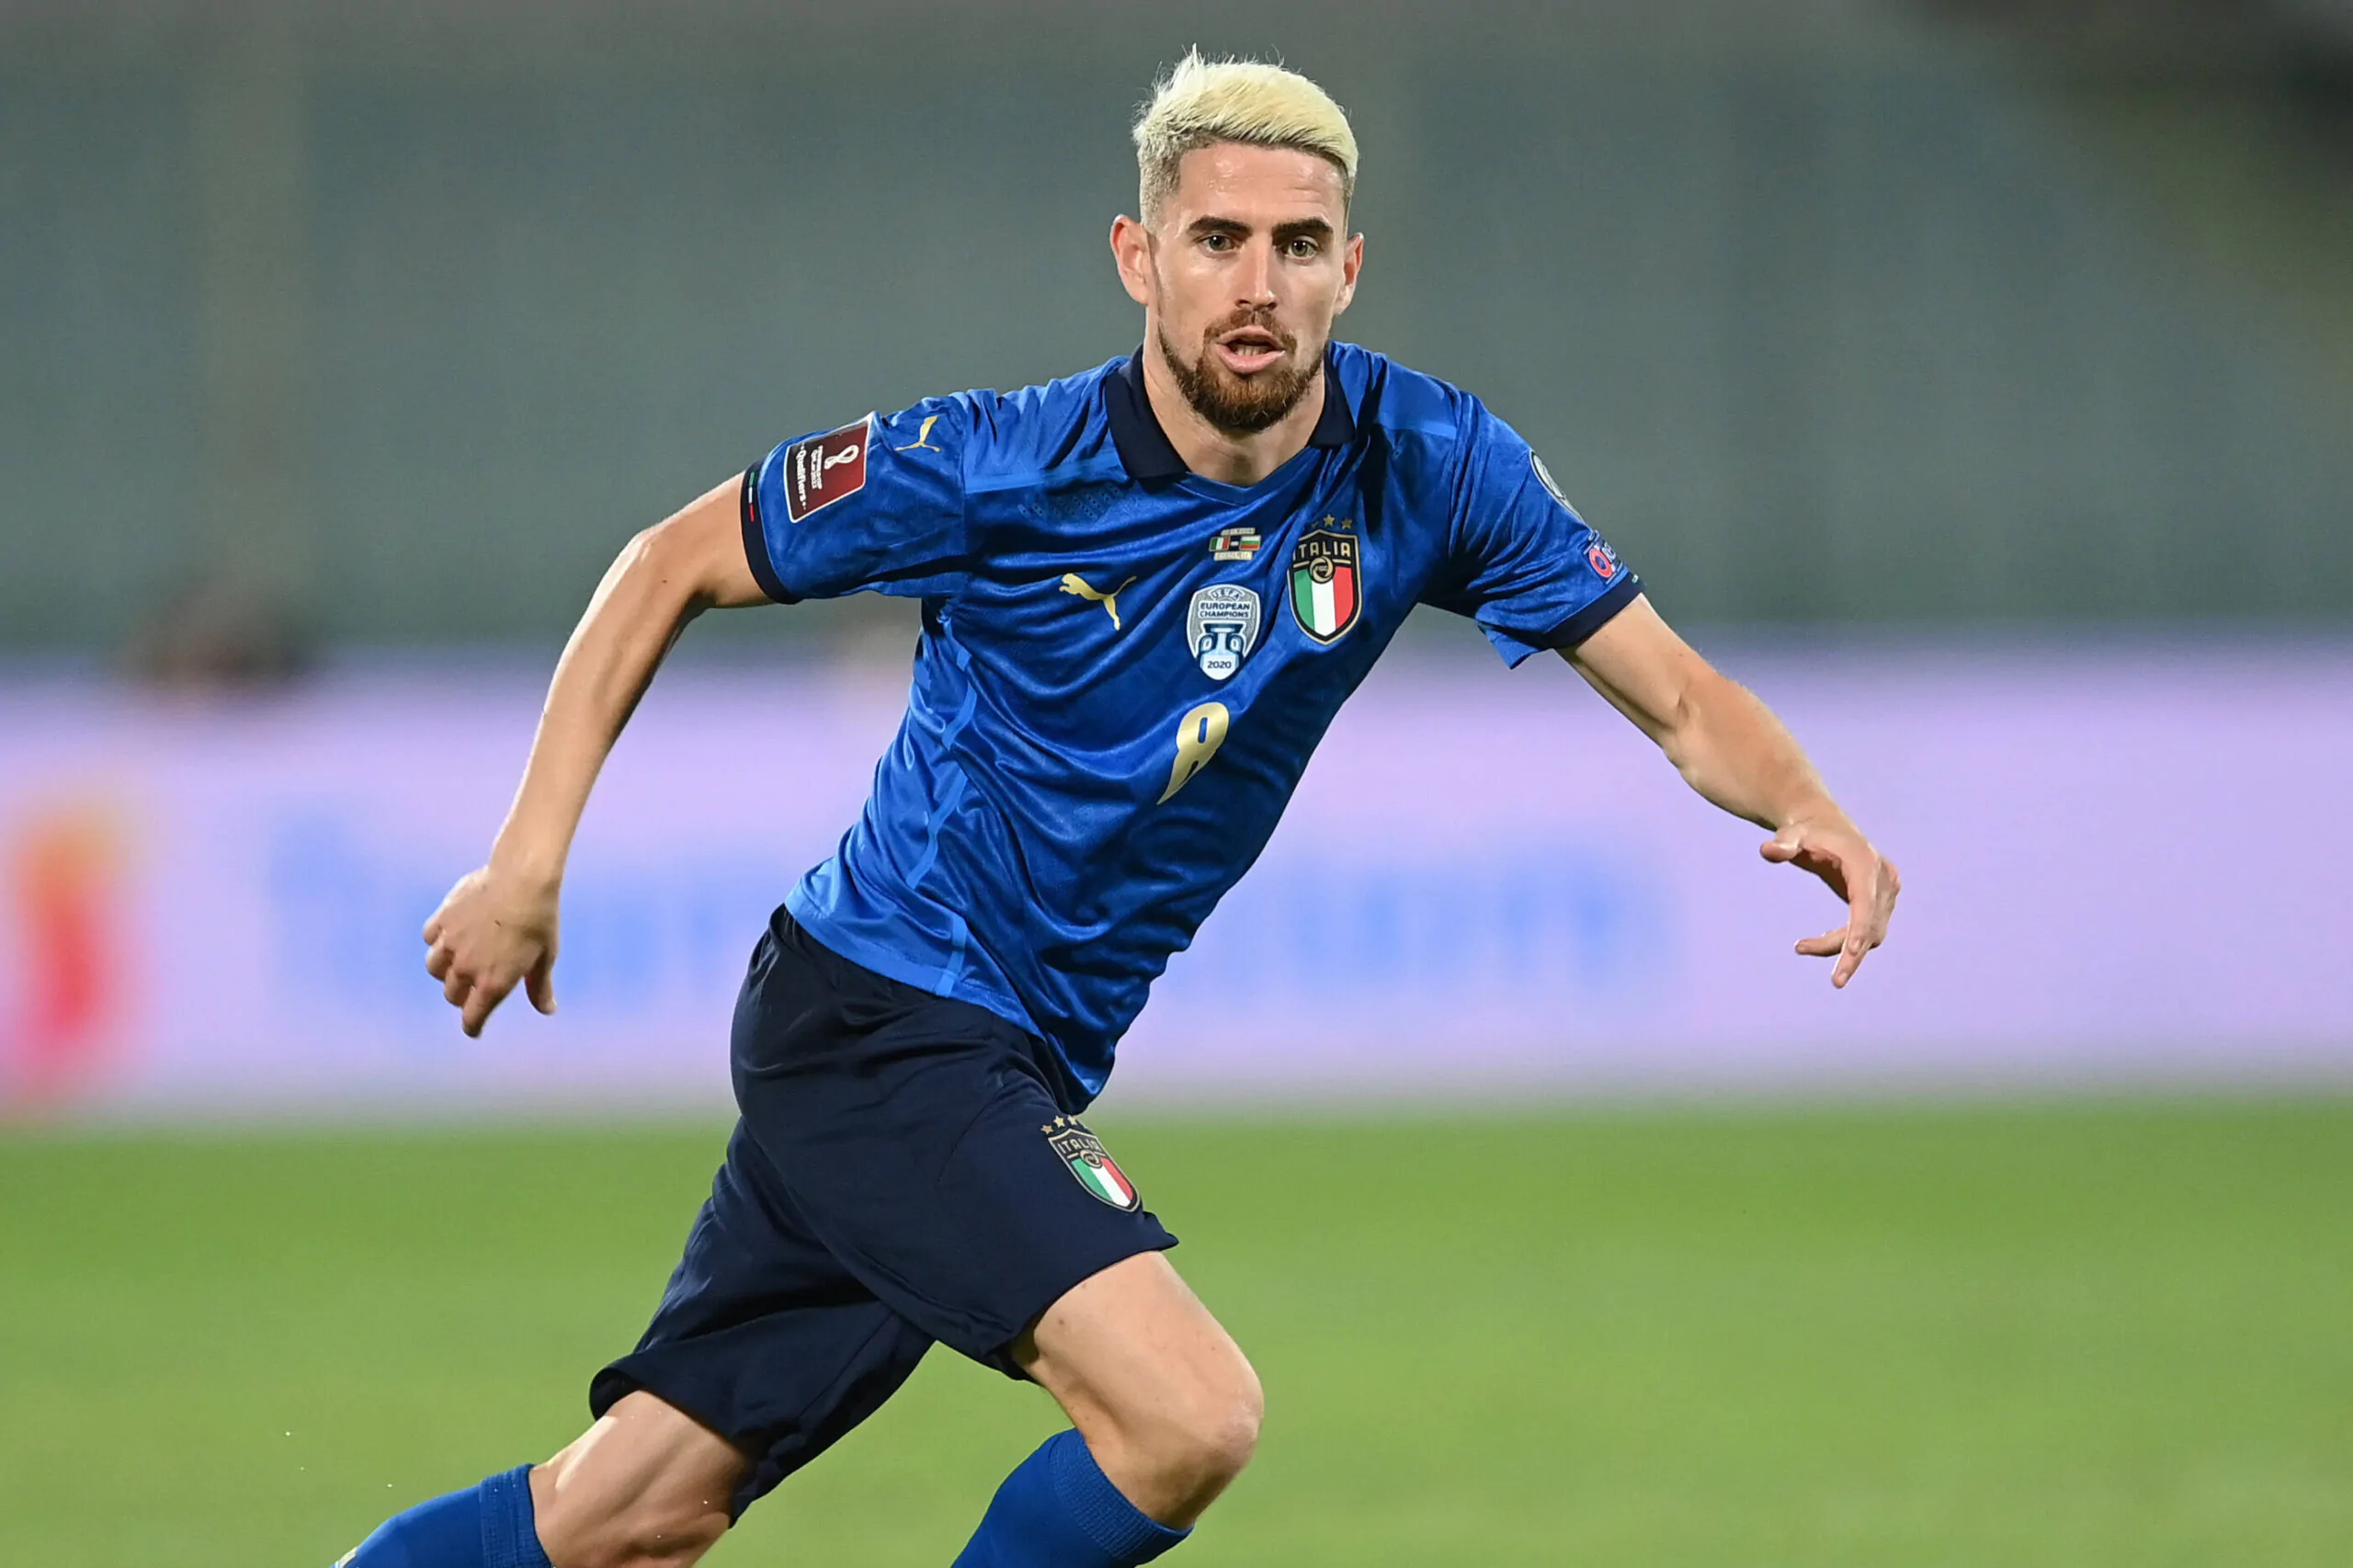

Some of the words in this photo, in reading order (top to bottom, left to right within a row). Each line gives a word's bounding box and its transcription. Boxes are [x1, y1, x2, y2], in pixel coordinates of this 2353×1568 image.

[795, 448, 807, 503] Qualifiers
[1292, 540, 1351, 562] ITALIA
[1214, 588, 1240, 599] UEFA
[1199, 602, 1250, 610] EUROPEAN
[1199, 610, 1249, 619] CHAMPIONS
[1207, 660, 1233, 669] 2020
[1156, 701, 1230, 805] 8
[1057, 1138, 1102, 1154] ITALIA
